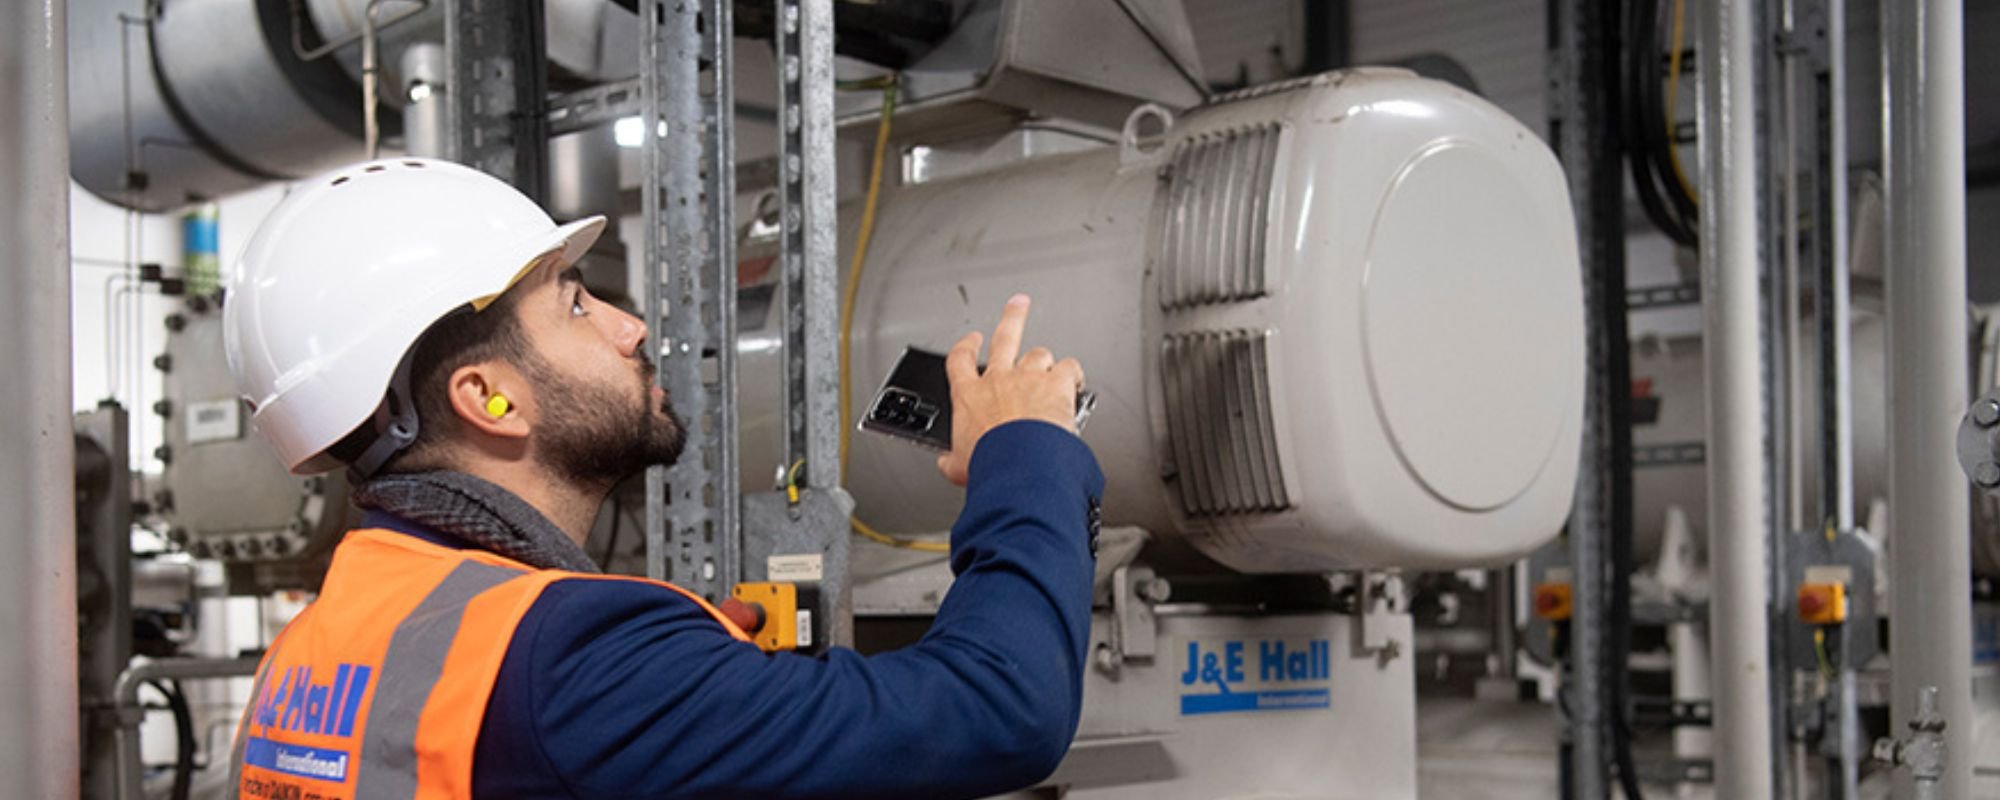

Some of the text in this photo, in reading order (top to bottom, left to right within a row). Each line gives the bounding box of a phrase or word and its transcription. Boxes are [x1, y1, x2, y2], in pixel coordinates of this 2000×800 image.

[1180, 639, 1330, 690] J&E Hall
[280, 663, 371, 737] Hall
